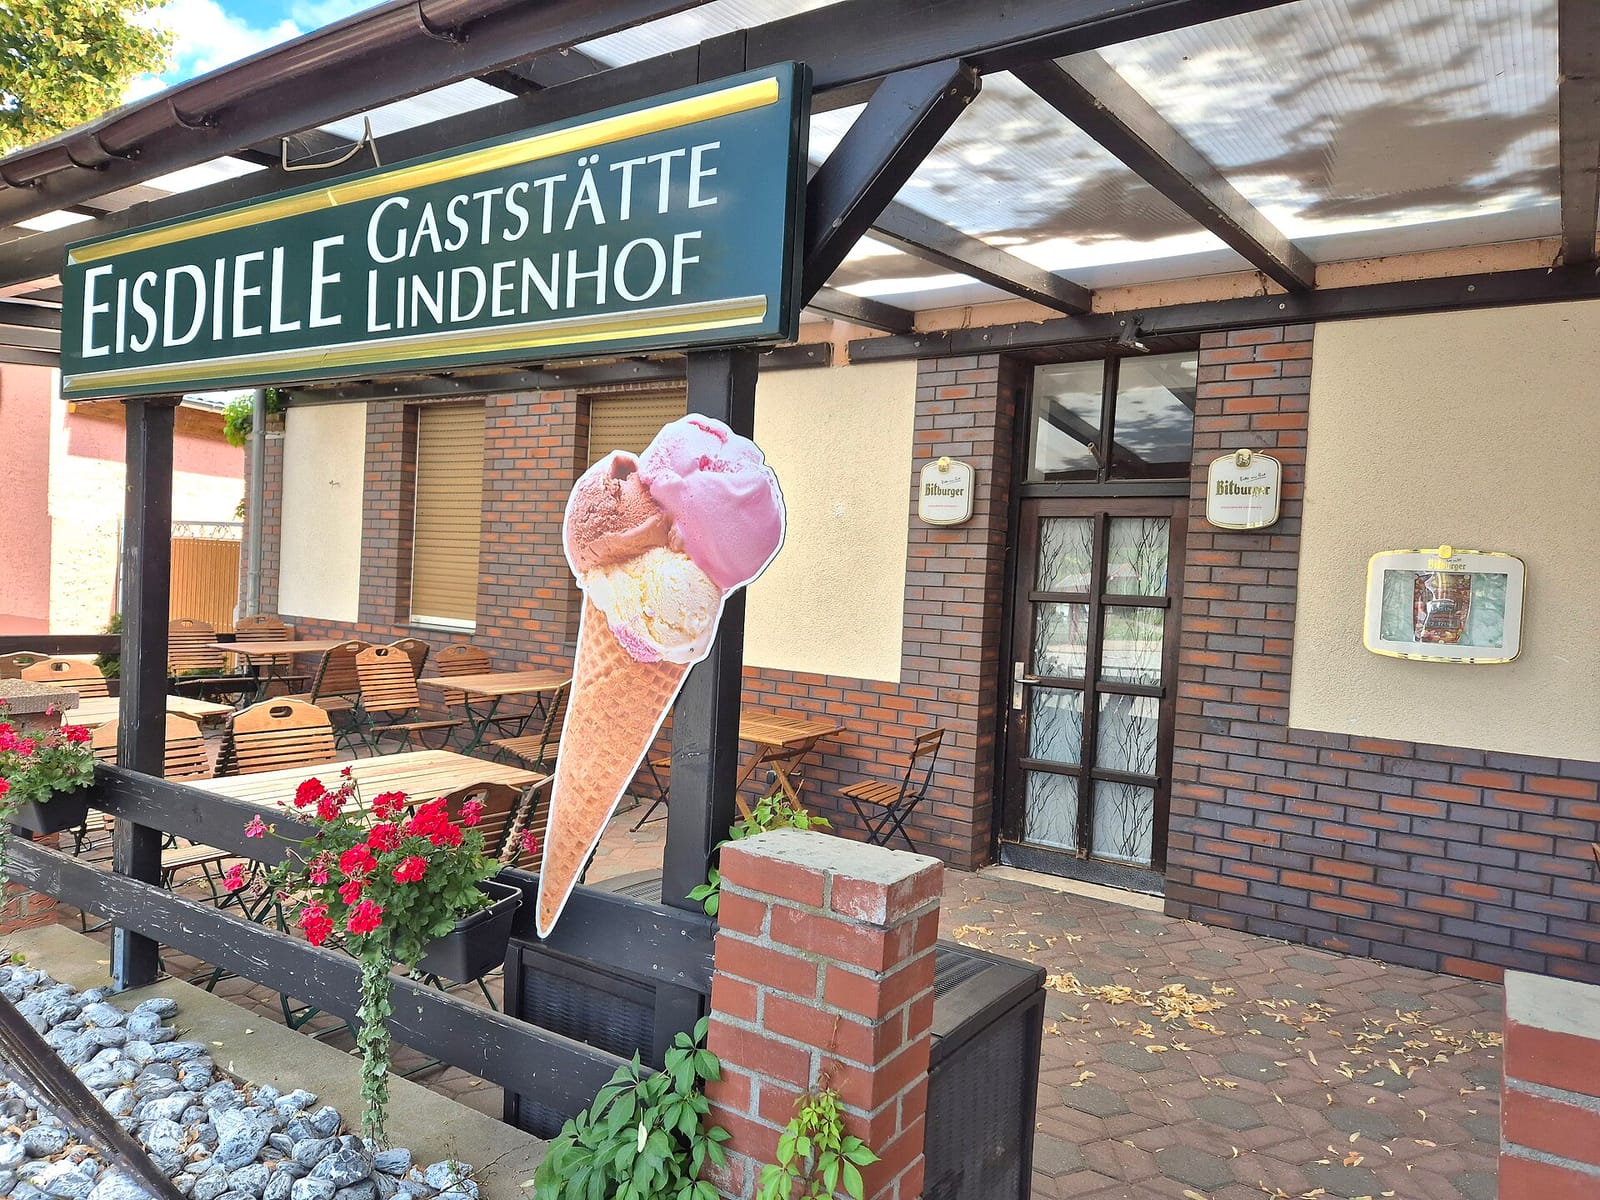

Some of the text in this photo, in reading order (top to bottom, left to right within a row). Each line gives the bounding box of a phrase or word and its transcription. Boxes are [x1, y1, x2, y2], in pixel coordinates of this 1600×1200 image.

[367, 141, 721, 264] GASTSTÄTTE
[81, 233, 345, 358] EISDIELE
[368, 231, 702, 332] LINDENHOF
[925, 483, 964, 498] Bitburger
